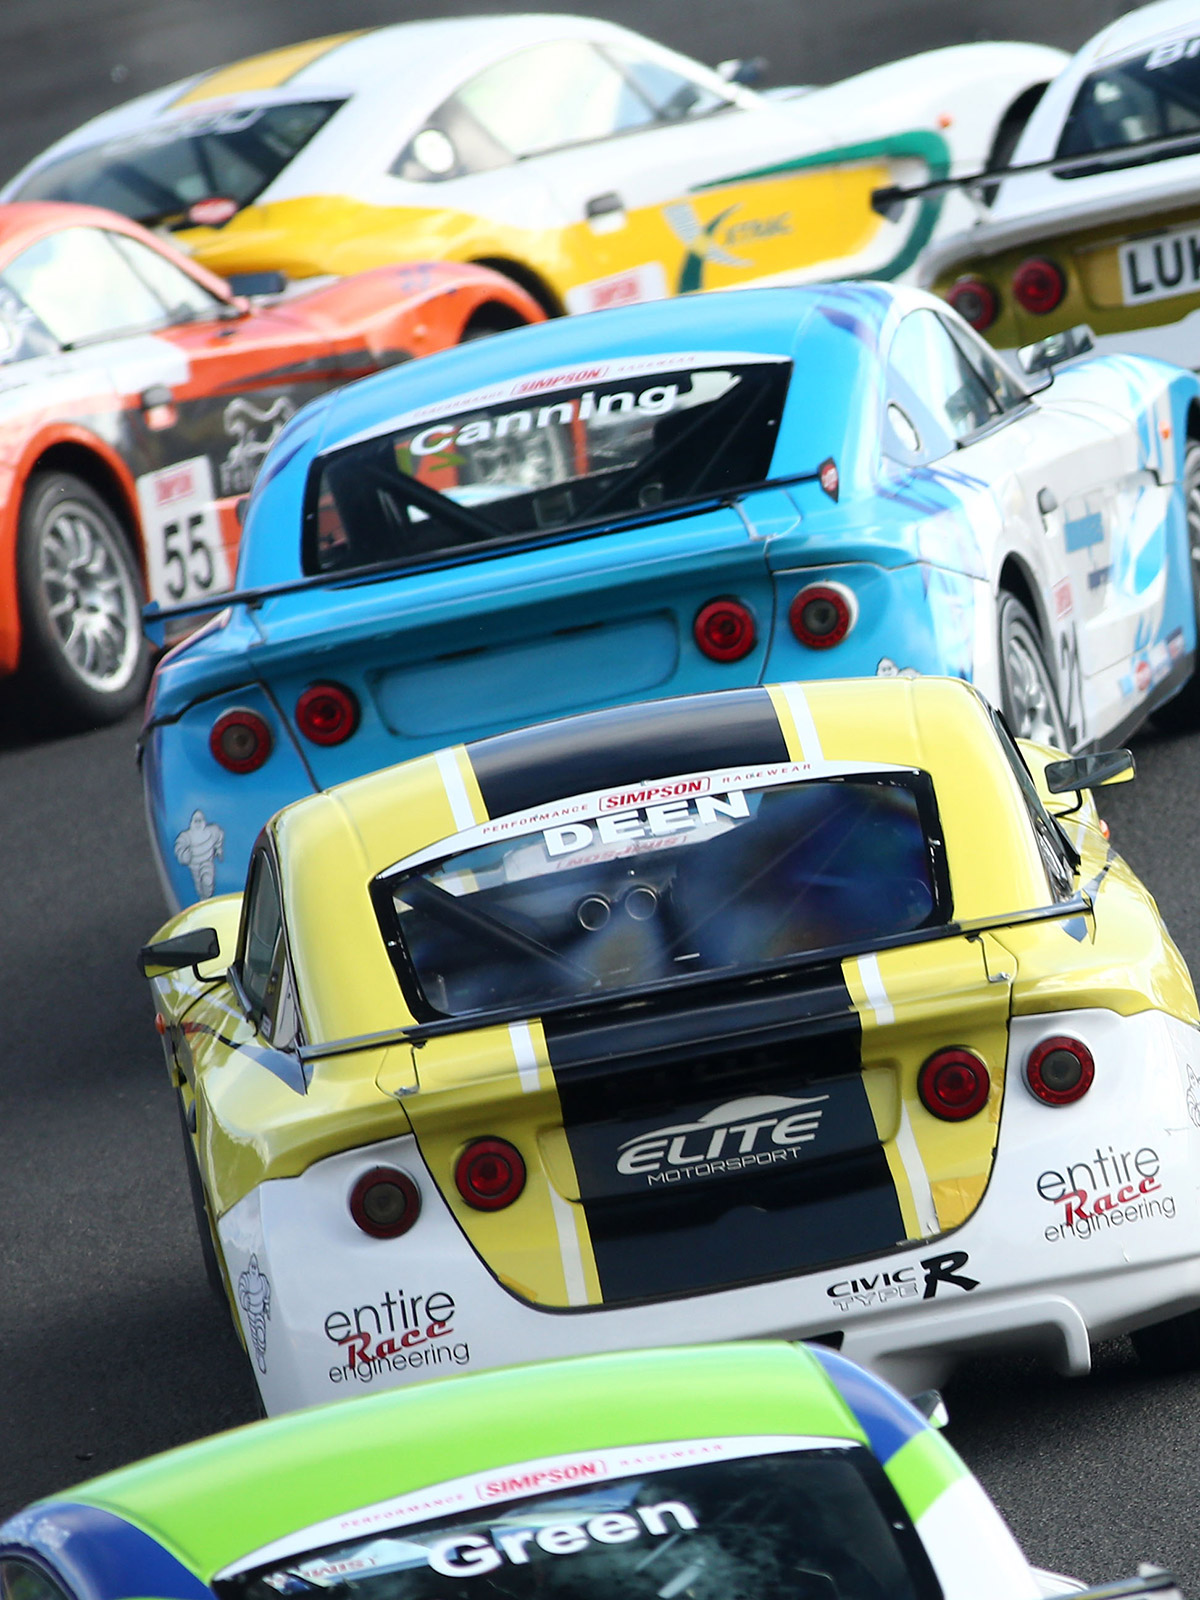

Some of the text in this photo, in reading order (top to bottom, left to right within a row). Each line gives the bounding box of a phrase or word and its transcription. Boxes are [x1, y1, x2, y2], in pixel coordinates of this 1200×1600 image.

[518, 368, 602, 393] SIMPSON
[409, 383, 679, 456] Canning
[163, 513, 214, 599] 55
[482, 763, 812, 834] PERFORMANCE SIMPSON RACEWEAR
[543, 790, 750, 857] DEEN
[617, 1110, 823, 1175] ELITE
[647, 1146, 802, 1186] MOTORSPORT
[1037, 1146, 1160, 1201] entire
[1044, 1196, 1176, 1242] engineering
[1053, 1176, 1161, 1227] Race
[827, 1266, 916, 1298] CIVIC
[832, 1251, 981, 1312] TYPE R
[324, 1289, 455, 1342] entire
[329, 1342, 470, 1383] engineering
[338, 1320, 454, 1370] Race
[485, 1461, 598, 1498] SIMPSON
[427, 1499, 698, 1579] Green
